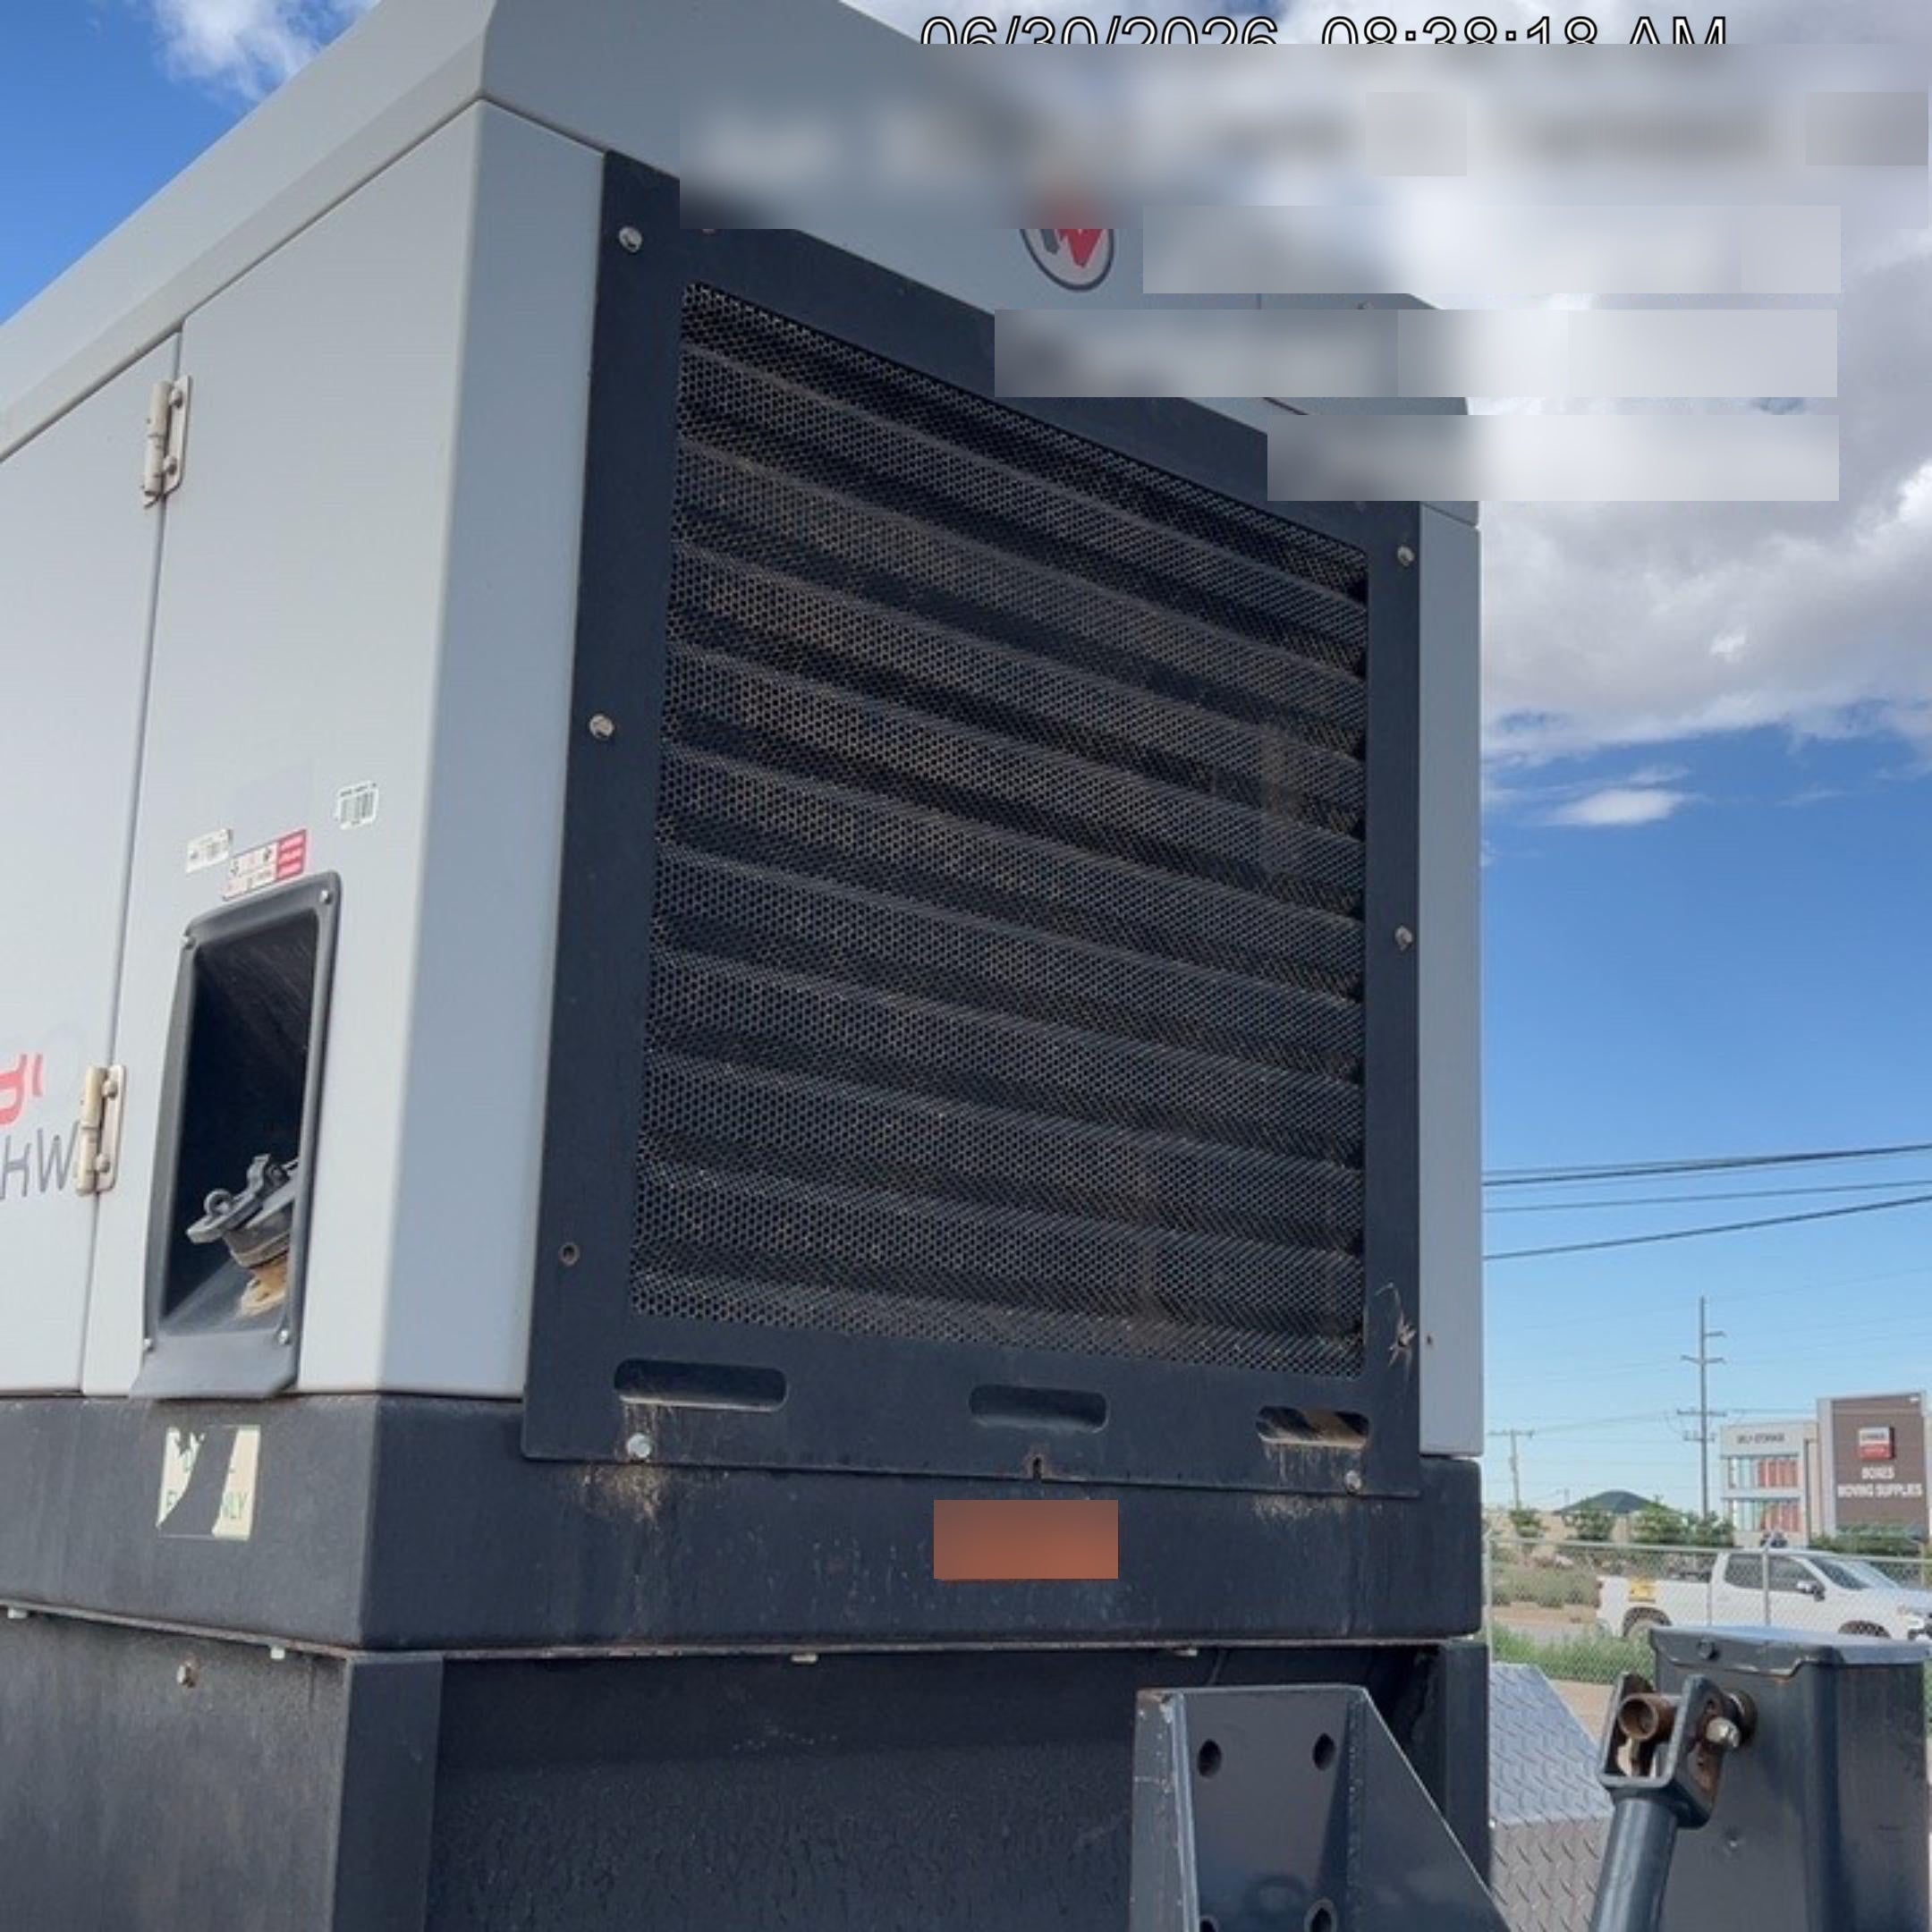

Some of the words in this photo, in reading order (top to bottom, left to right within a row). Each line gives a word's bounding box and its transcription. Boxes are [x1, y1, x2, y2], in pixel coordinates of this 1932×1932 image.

[1861, 1466, 1895, 1479] BOXES
[1837, 1482, 1874, 1498] MOVING
[1875, 1482, 1923, 1497] SUPPLIES
